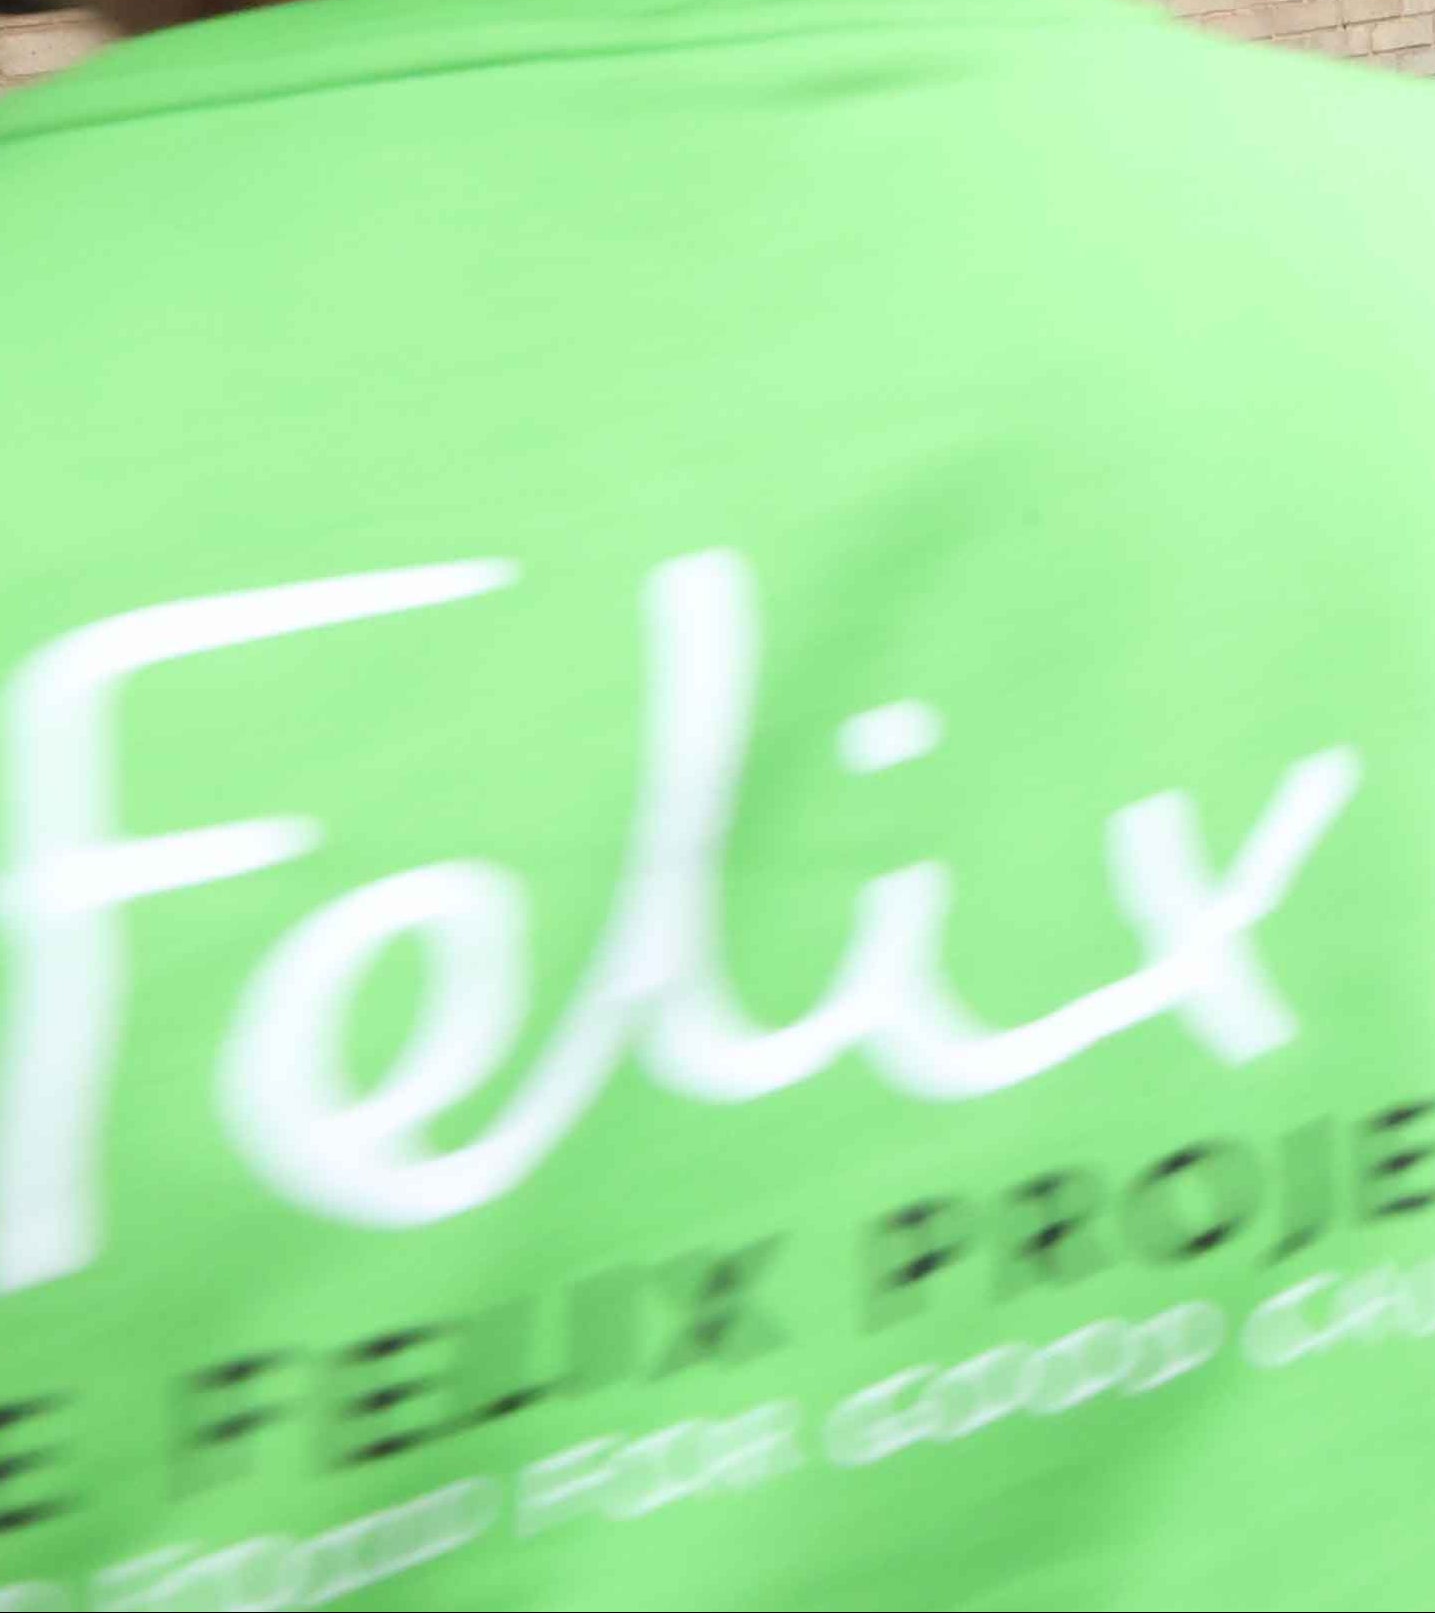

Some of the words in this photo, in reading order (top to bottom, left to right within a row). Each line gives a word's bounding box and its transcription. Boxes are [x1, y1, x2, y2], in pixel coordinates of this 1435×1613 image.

[0, 546, 1366, 1294] Felix
[165, 1229, 795, 1504] FELIX
[822, 1299, 1228, 1469] GOOD
